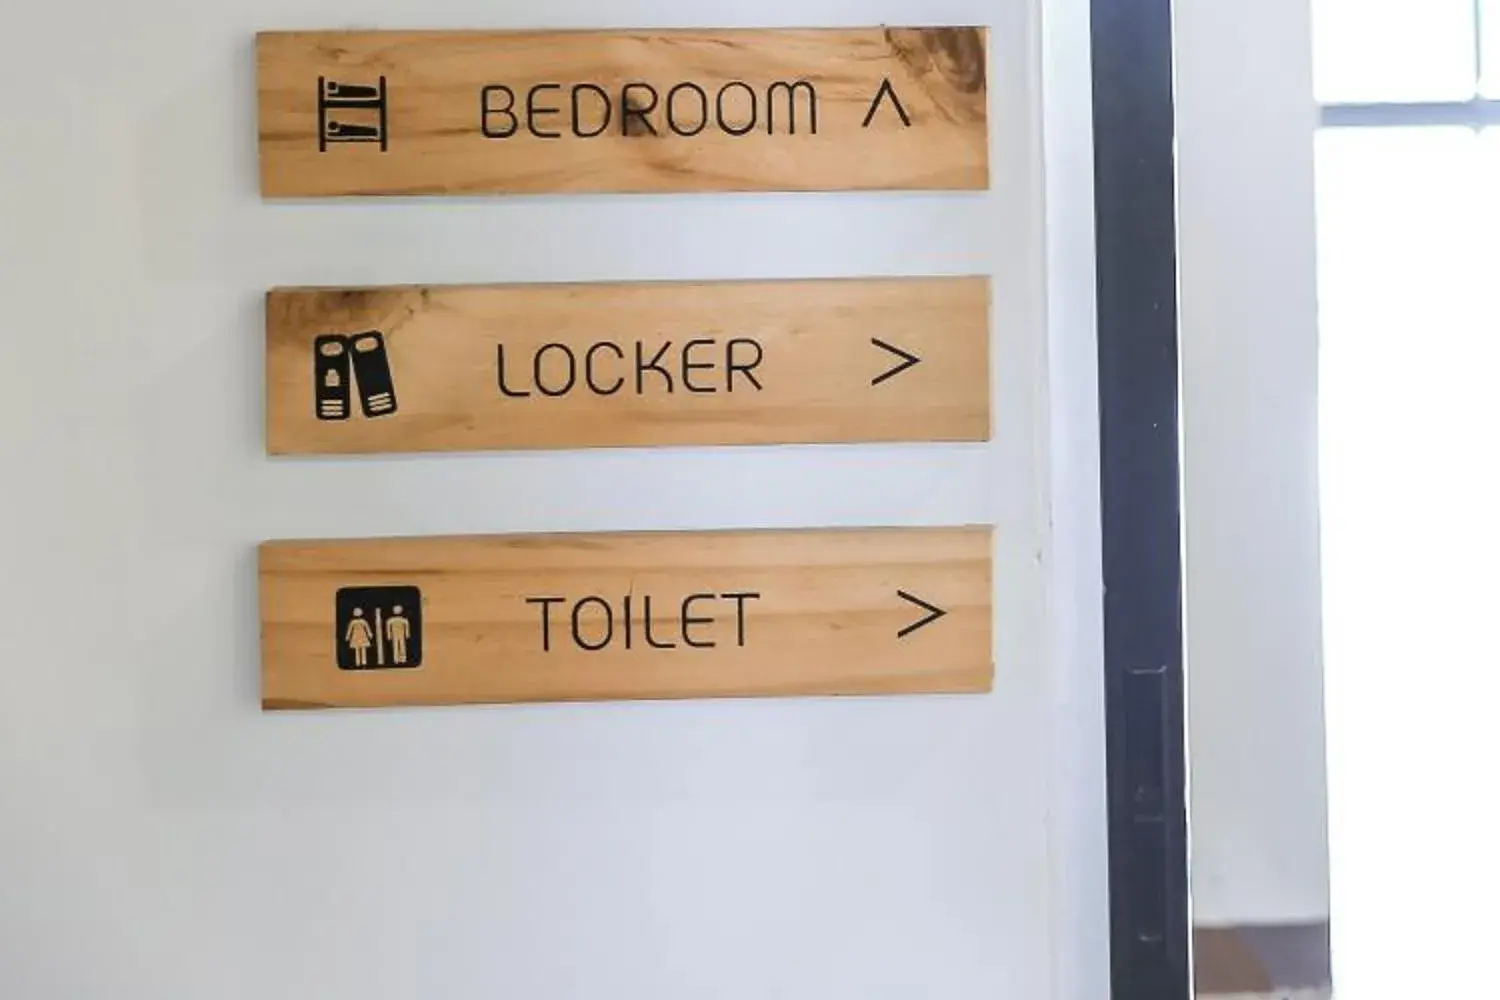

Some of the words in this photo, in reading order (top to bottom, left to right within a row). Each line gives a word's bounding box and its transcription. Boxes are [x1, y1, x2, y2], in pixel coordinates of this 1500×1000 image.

[480, 80, 818, 140] BEDROOM
[497, 338, 764, 398] LOCKER
[525, 592, 761, 653] TOILET
